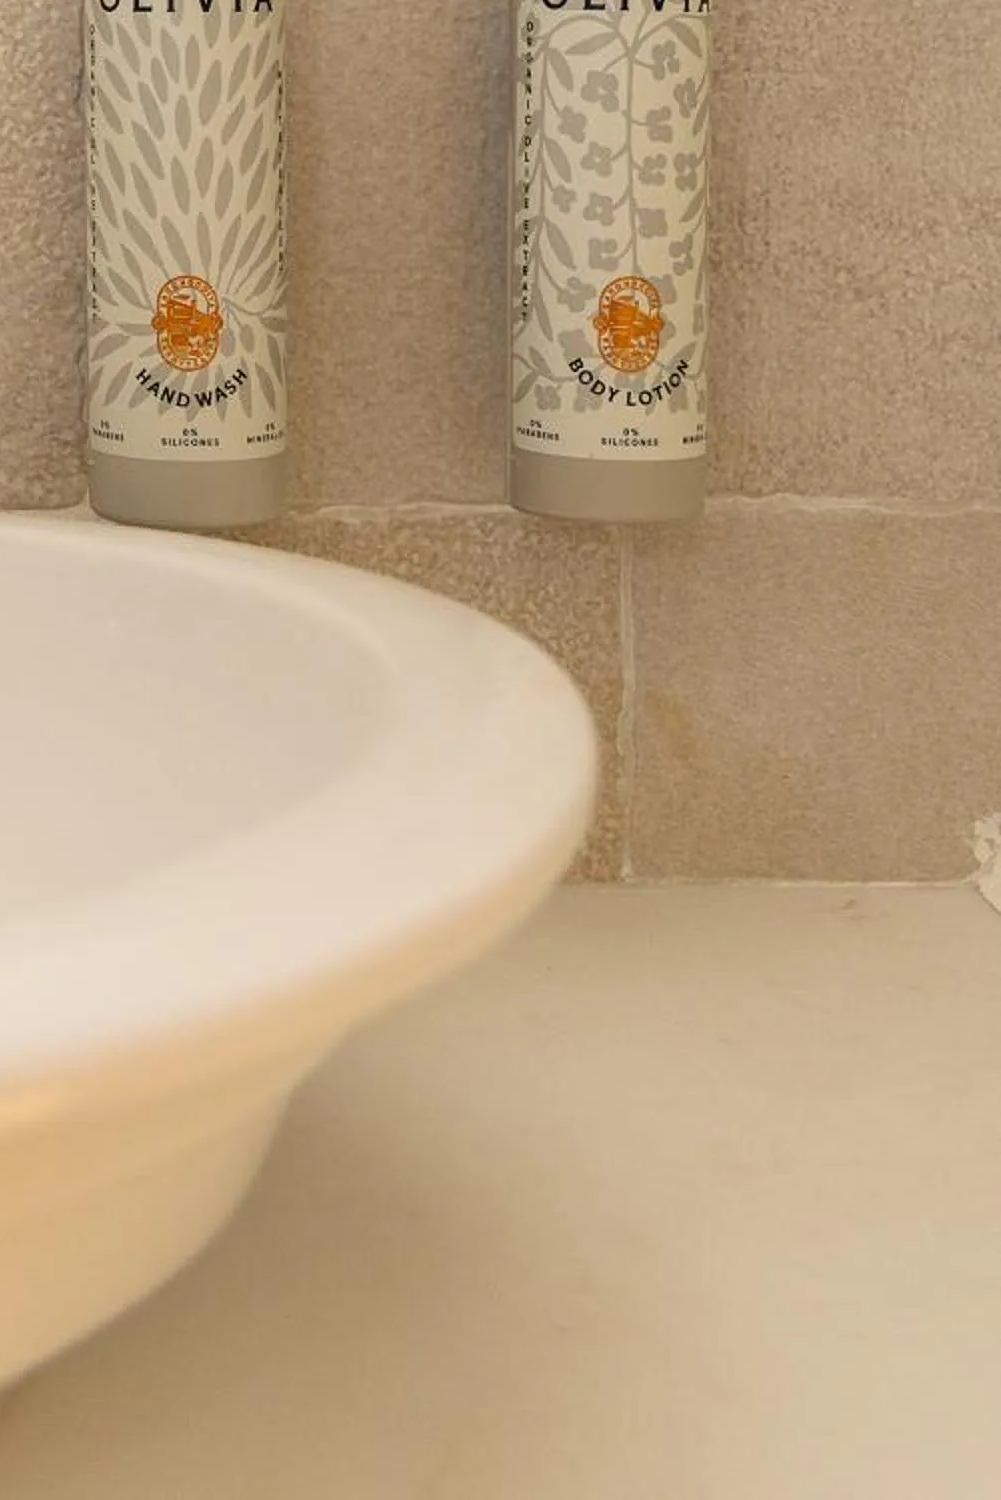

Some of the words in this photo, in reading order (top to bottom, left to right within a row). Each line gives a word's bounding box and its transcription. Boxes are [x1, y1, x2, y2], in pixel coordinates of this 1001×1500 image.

[136, 368, 190, 408] HAND
[194, 368, 248, 408] WASH
[568, 357, 621, 403] BODY
[625, 359, 689, 407] LOTION
